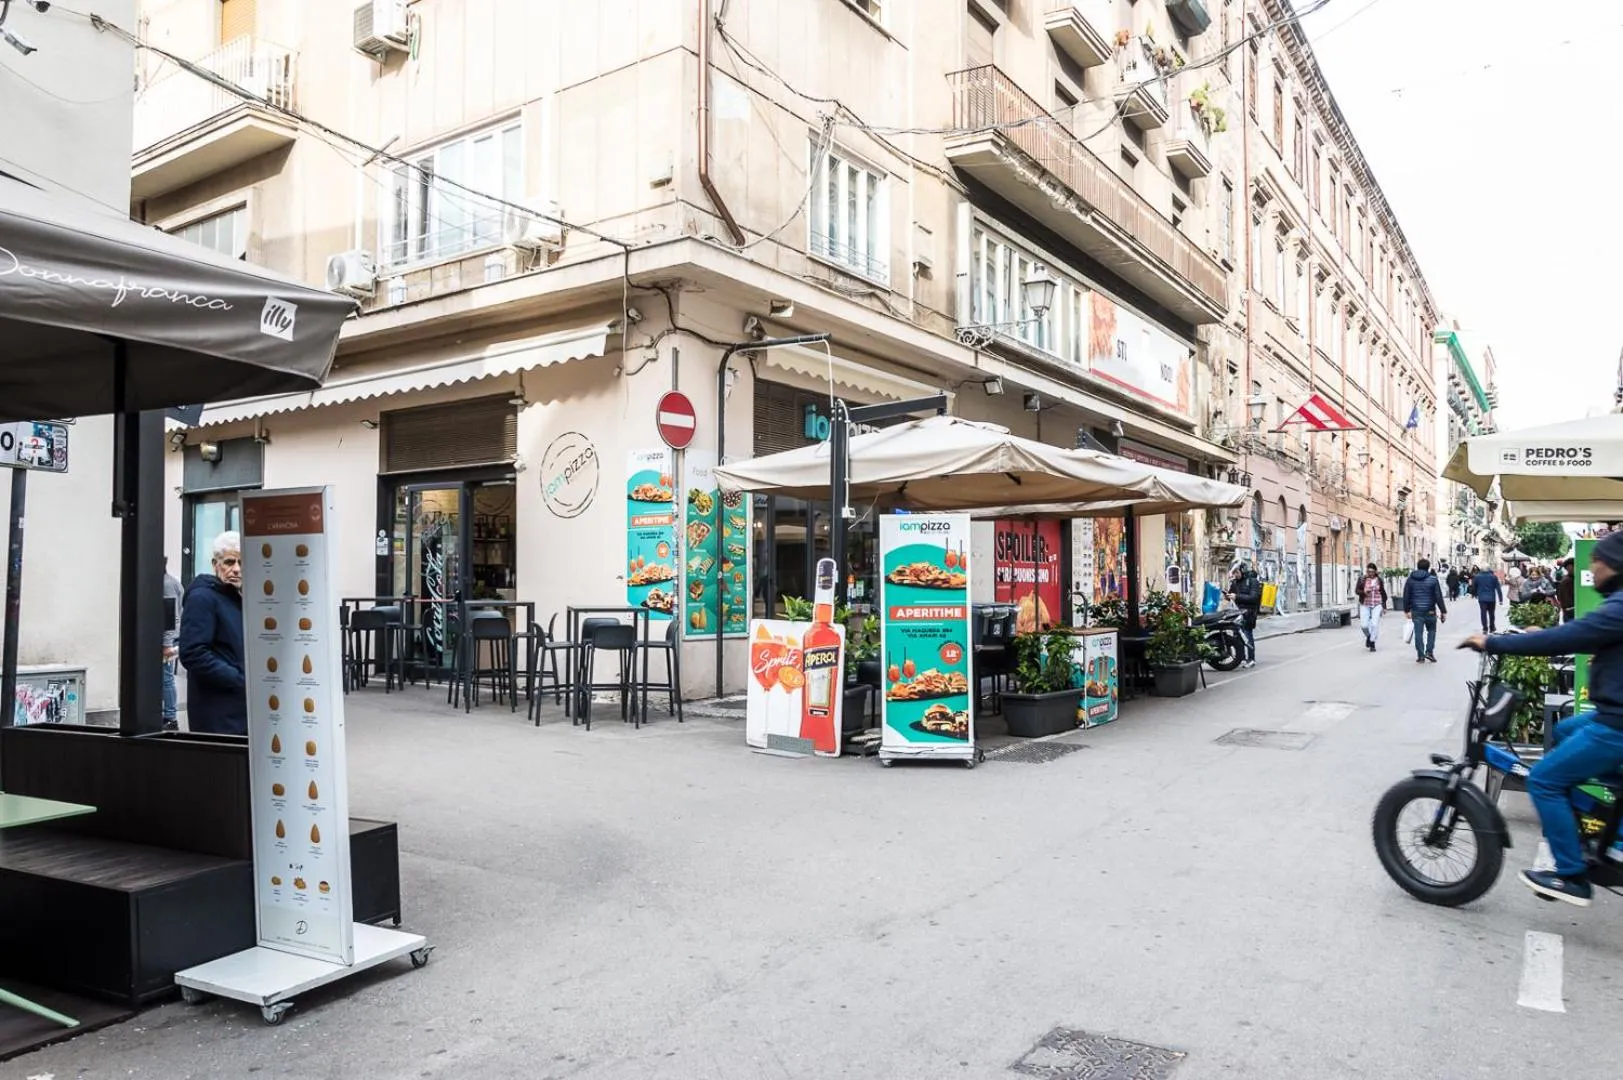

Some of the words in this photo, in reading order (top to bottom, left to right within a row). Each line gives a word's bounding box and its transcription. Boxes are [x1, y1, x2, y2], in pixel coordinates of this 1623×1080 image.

[263, 304, 292, 332] illy
[1525, 447, 1592, 458] PEDRO'S
[900, 520, 951, 533] iampizza
[896, 607, 961, 618] APERITIME
[805, 652, 836, 667] APEROL
